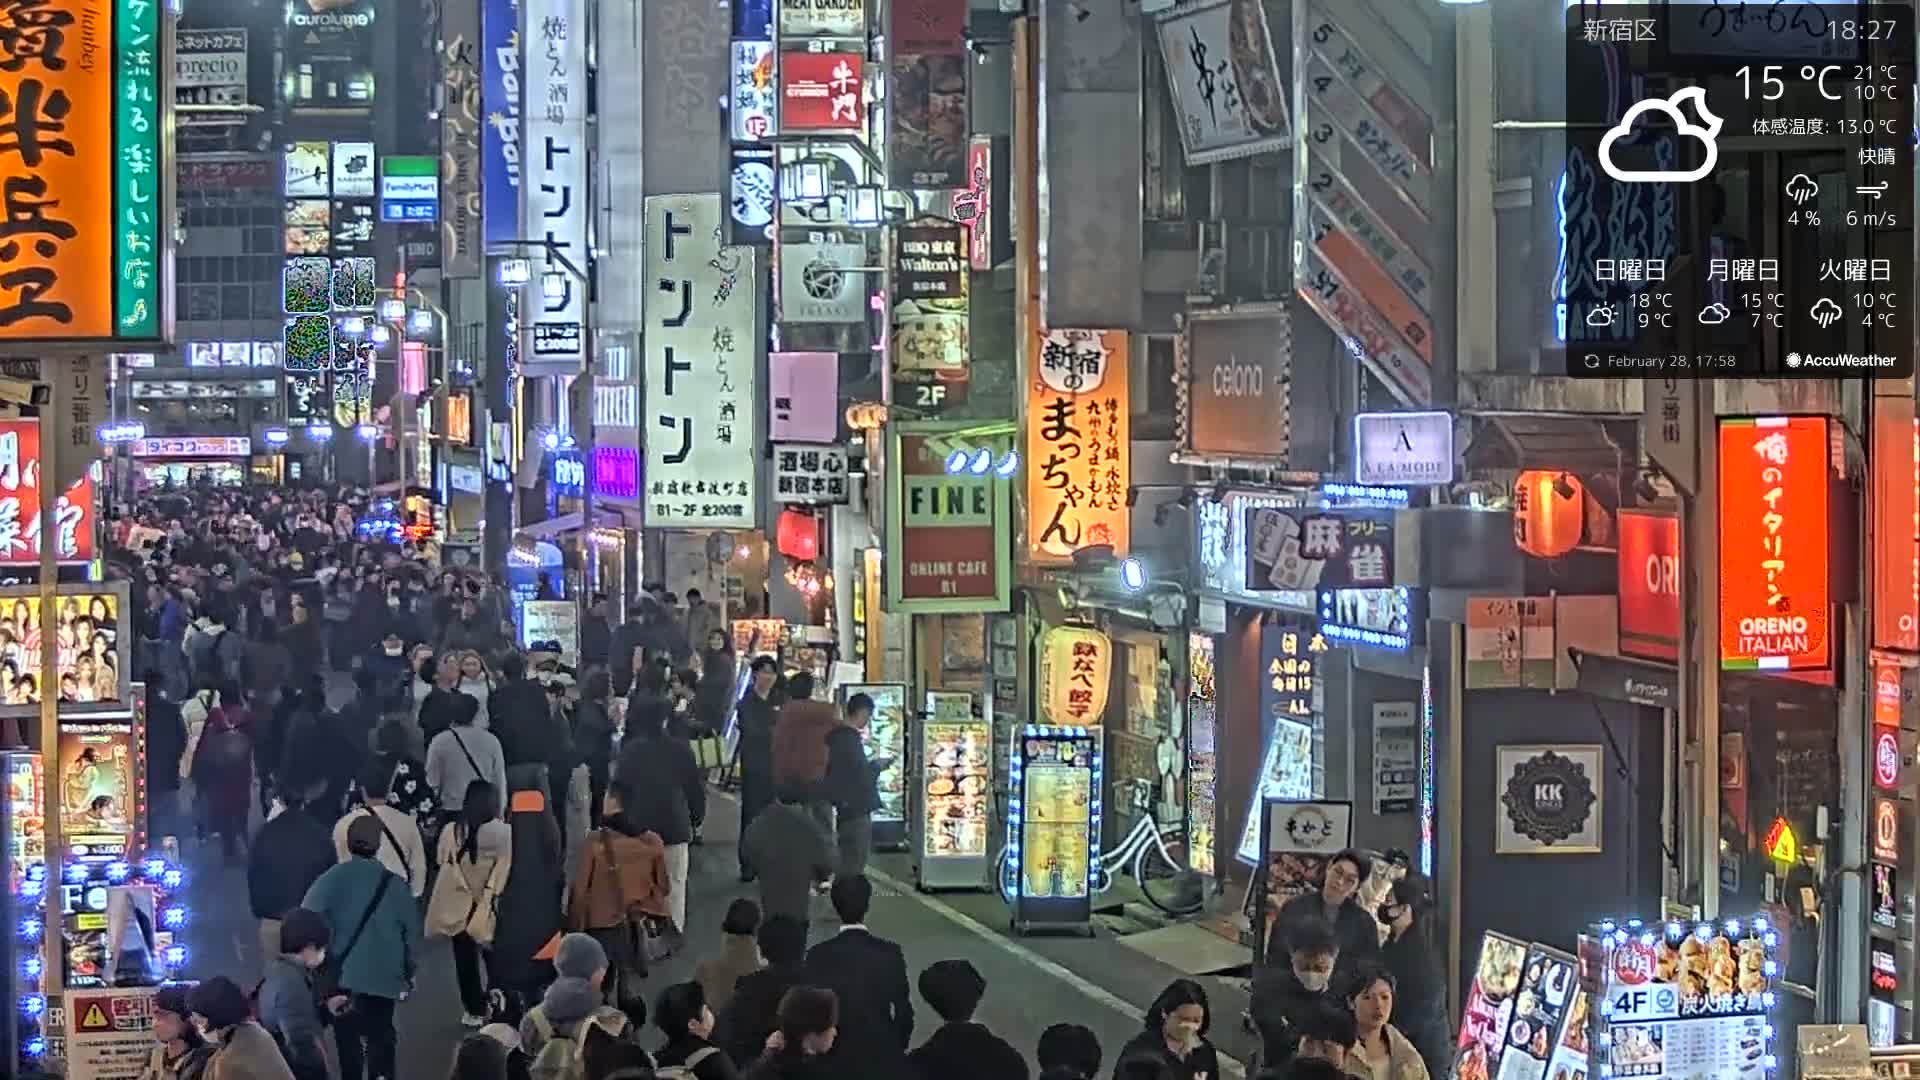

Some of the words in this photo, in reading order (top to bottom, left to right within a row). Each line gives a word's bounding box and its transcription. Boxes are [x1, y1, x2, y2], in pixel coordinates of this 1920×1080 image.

[1313, 24, 1333, 44] 5
[829, 59, 858, 121] 牛門
[1314, 75, 1332, 92] 4
[1313, 124, 1334, 143] 3
[1312, 174, 1333, 192] 2
[901, 256, 959, 272] Walton's
[659, 209, 692, 465] トントン
[712, 325, 736, 393] 焼とん
[1043, 343, 1102, 376] 新宿
[1064, 374, 1083, 390] の
[916, 386, 946, 406] 2F
[779, 451, 844, 473] 酒場心
[1040, 398, 1084, 546] まっちゃん
[911, 486, 986, 514] FINE
[1350, 520, 1389, 536] フリー
[1753, 432, 1791, 607] 俺のイタリアン
[910, 561, 952, 576] ONLINE
[958, 561, 987, 576] CAFE
[1740, 617, 1808, 635] ORENO
[1739, 635, 1808, 654] ITALIAN
[1535, 784, 1563, 800] KK
[1615, 992, 1647, 1013] 4F
